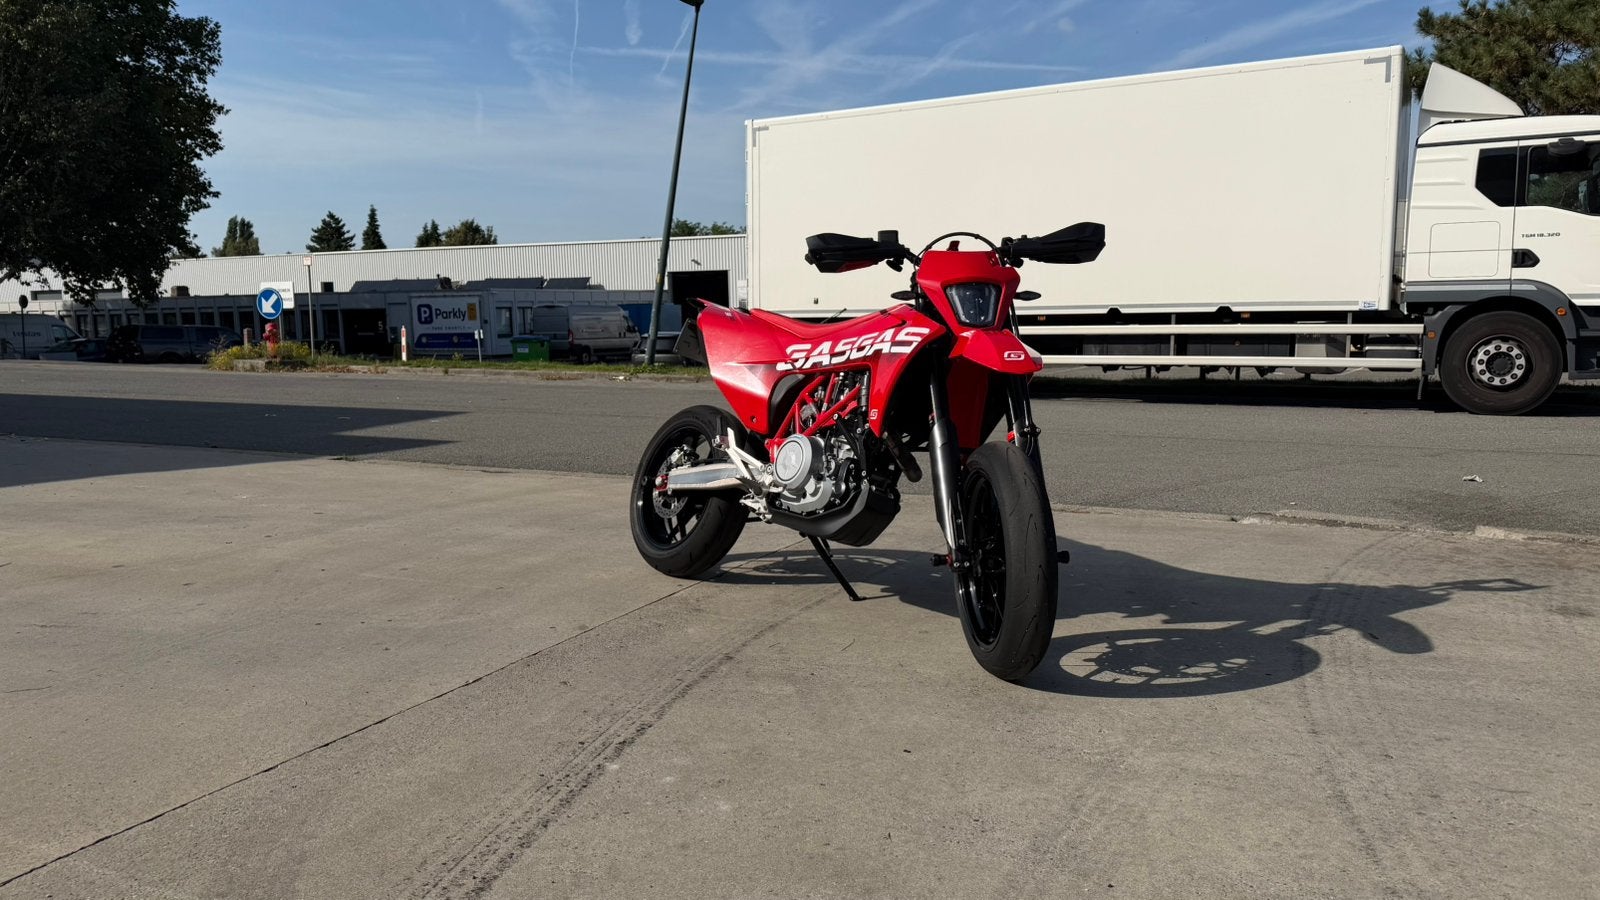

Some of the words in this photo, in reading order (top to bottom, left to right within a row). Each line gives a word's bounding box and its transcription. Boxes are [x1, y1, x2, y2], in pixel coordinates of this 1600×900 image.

[434, 308, 467, 321] Parkly
[377, 320, 384, 331] 5
[775, 327, 930, 371] GASGAS
